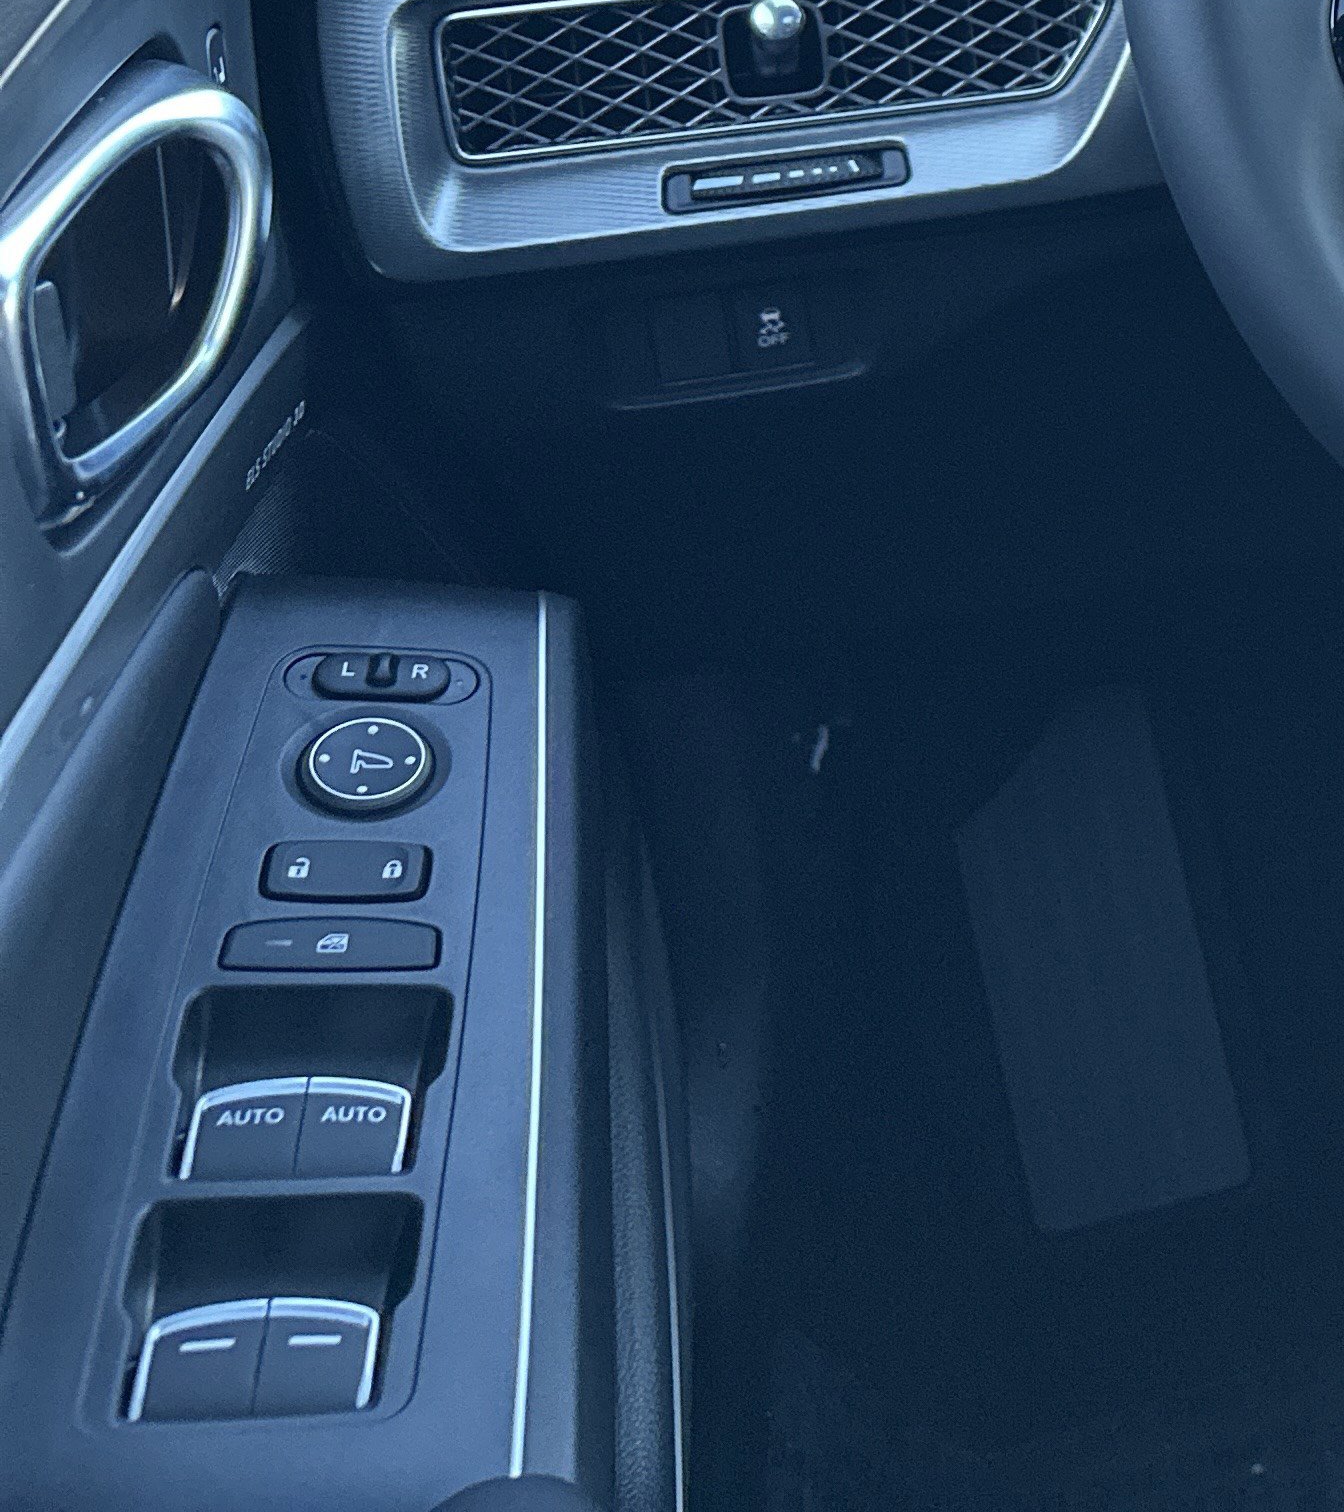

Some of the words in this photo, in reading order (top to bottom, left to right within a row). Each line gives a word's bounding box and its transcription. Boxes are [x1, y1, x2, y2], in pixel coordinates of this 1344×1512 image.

[341, 661, 356, 677] L
[411, 663, 429, 679] R
[216, 1107, 285, 1126] AUTO
[320, 1105, 387, 1123] AUTO
